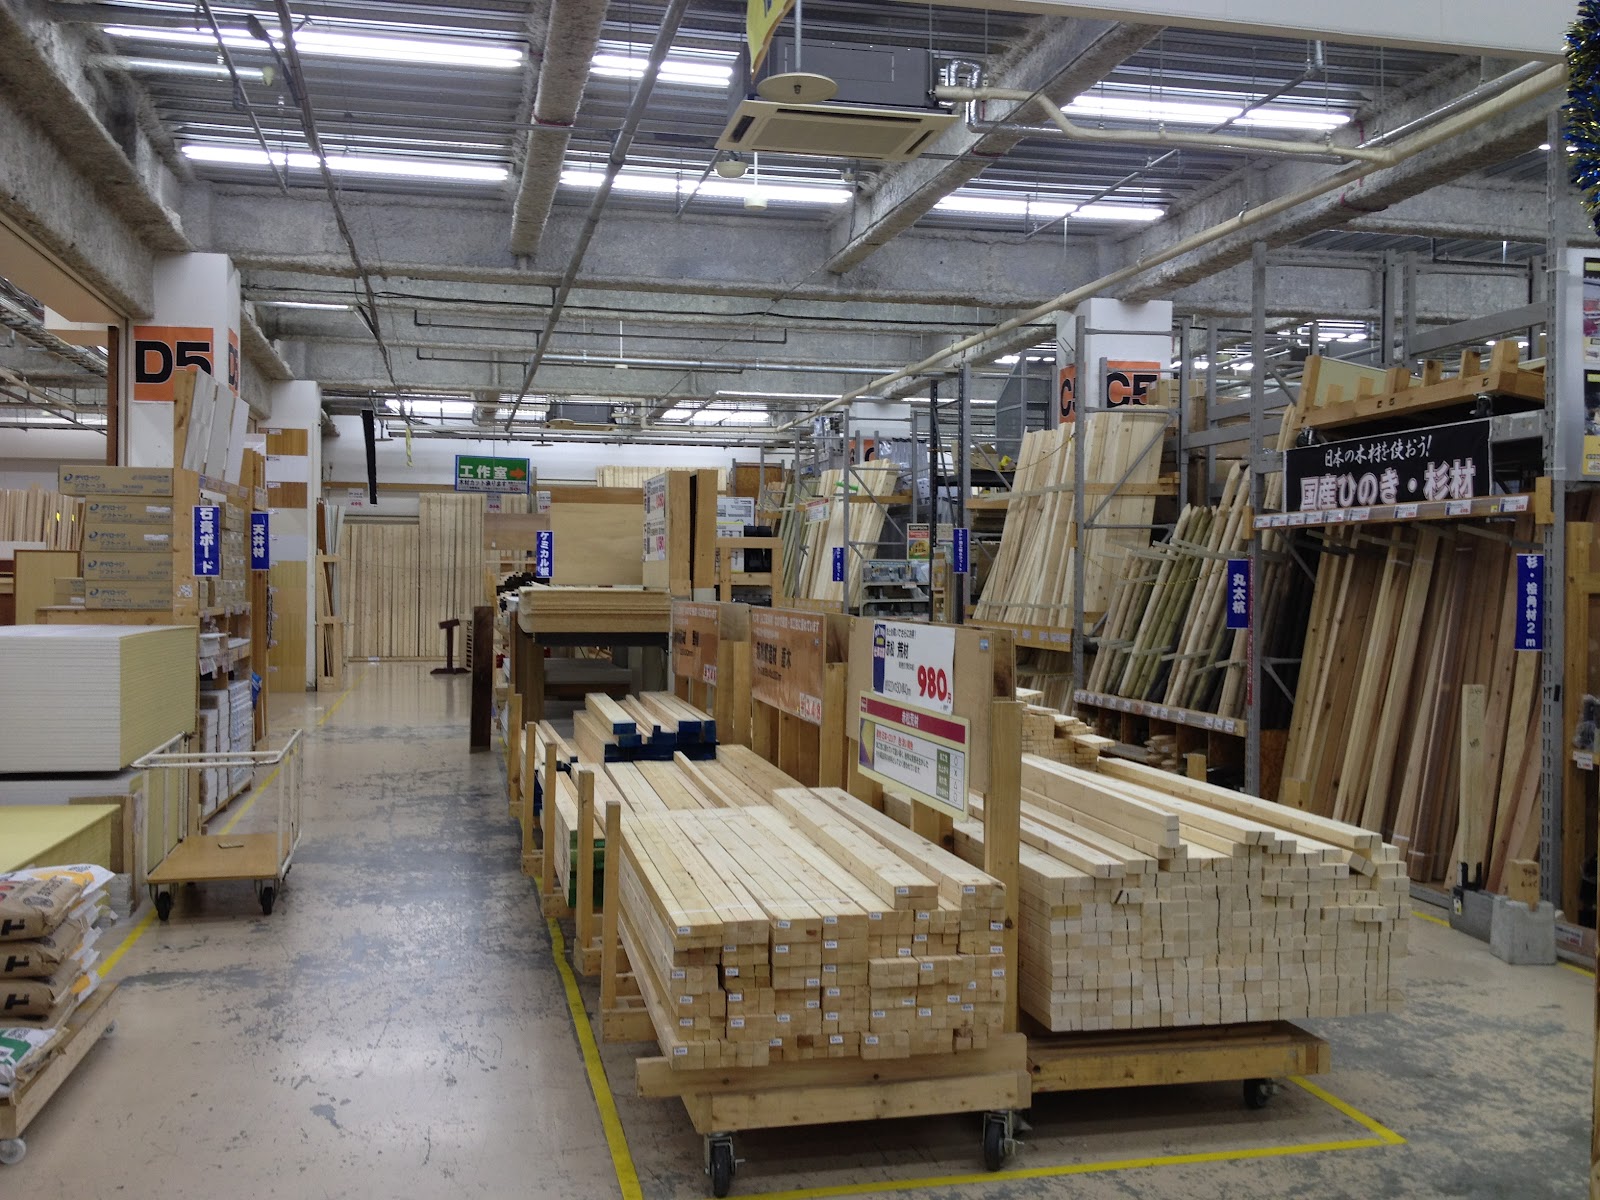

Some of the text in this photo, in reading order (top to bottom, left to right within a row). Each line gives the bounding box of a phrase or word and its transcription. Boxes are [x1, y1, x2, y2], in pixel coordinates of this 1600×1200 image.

[135, 340, 211, 383] D5
[459, 464, 508, 480] 工作室
[1300, 457, 1476, 511] 国産ひのき・杉材
[200, 508, 214, 574] 石膏ボード
[253, 524, 265, 558] 天井材
[540, 531, 550, 576] ケミカル板
[1232, 573, 1247, 614] 丸太杭
